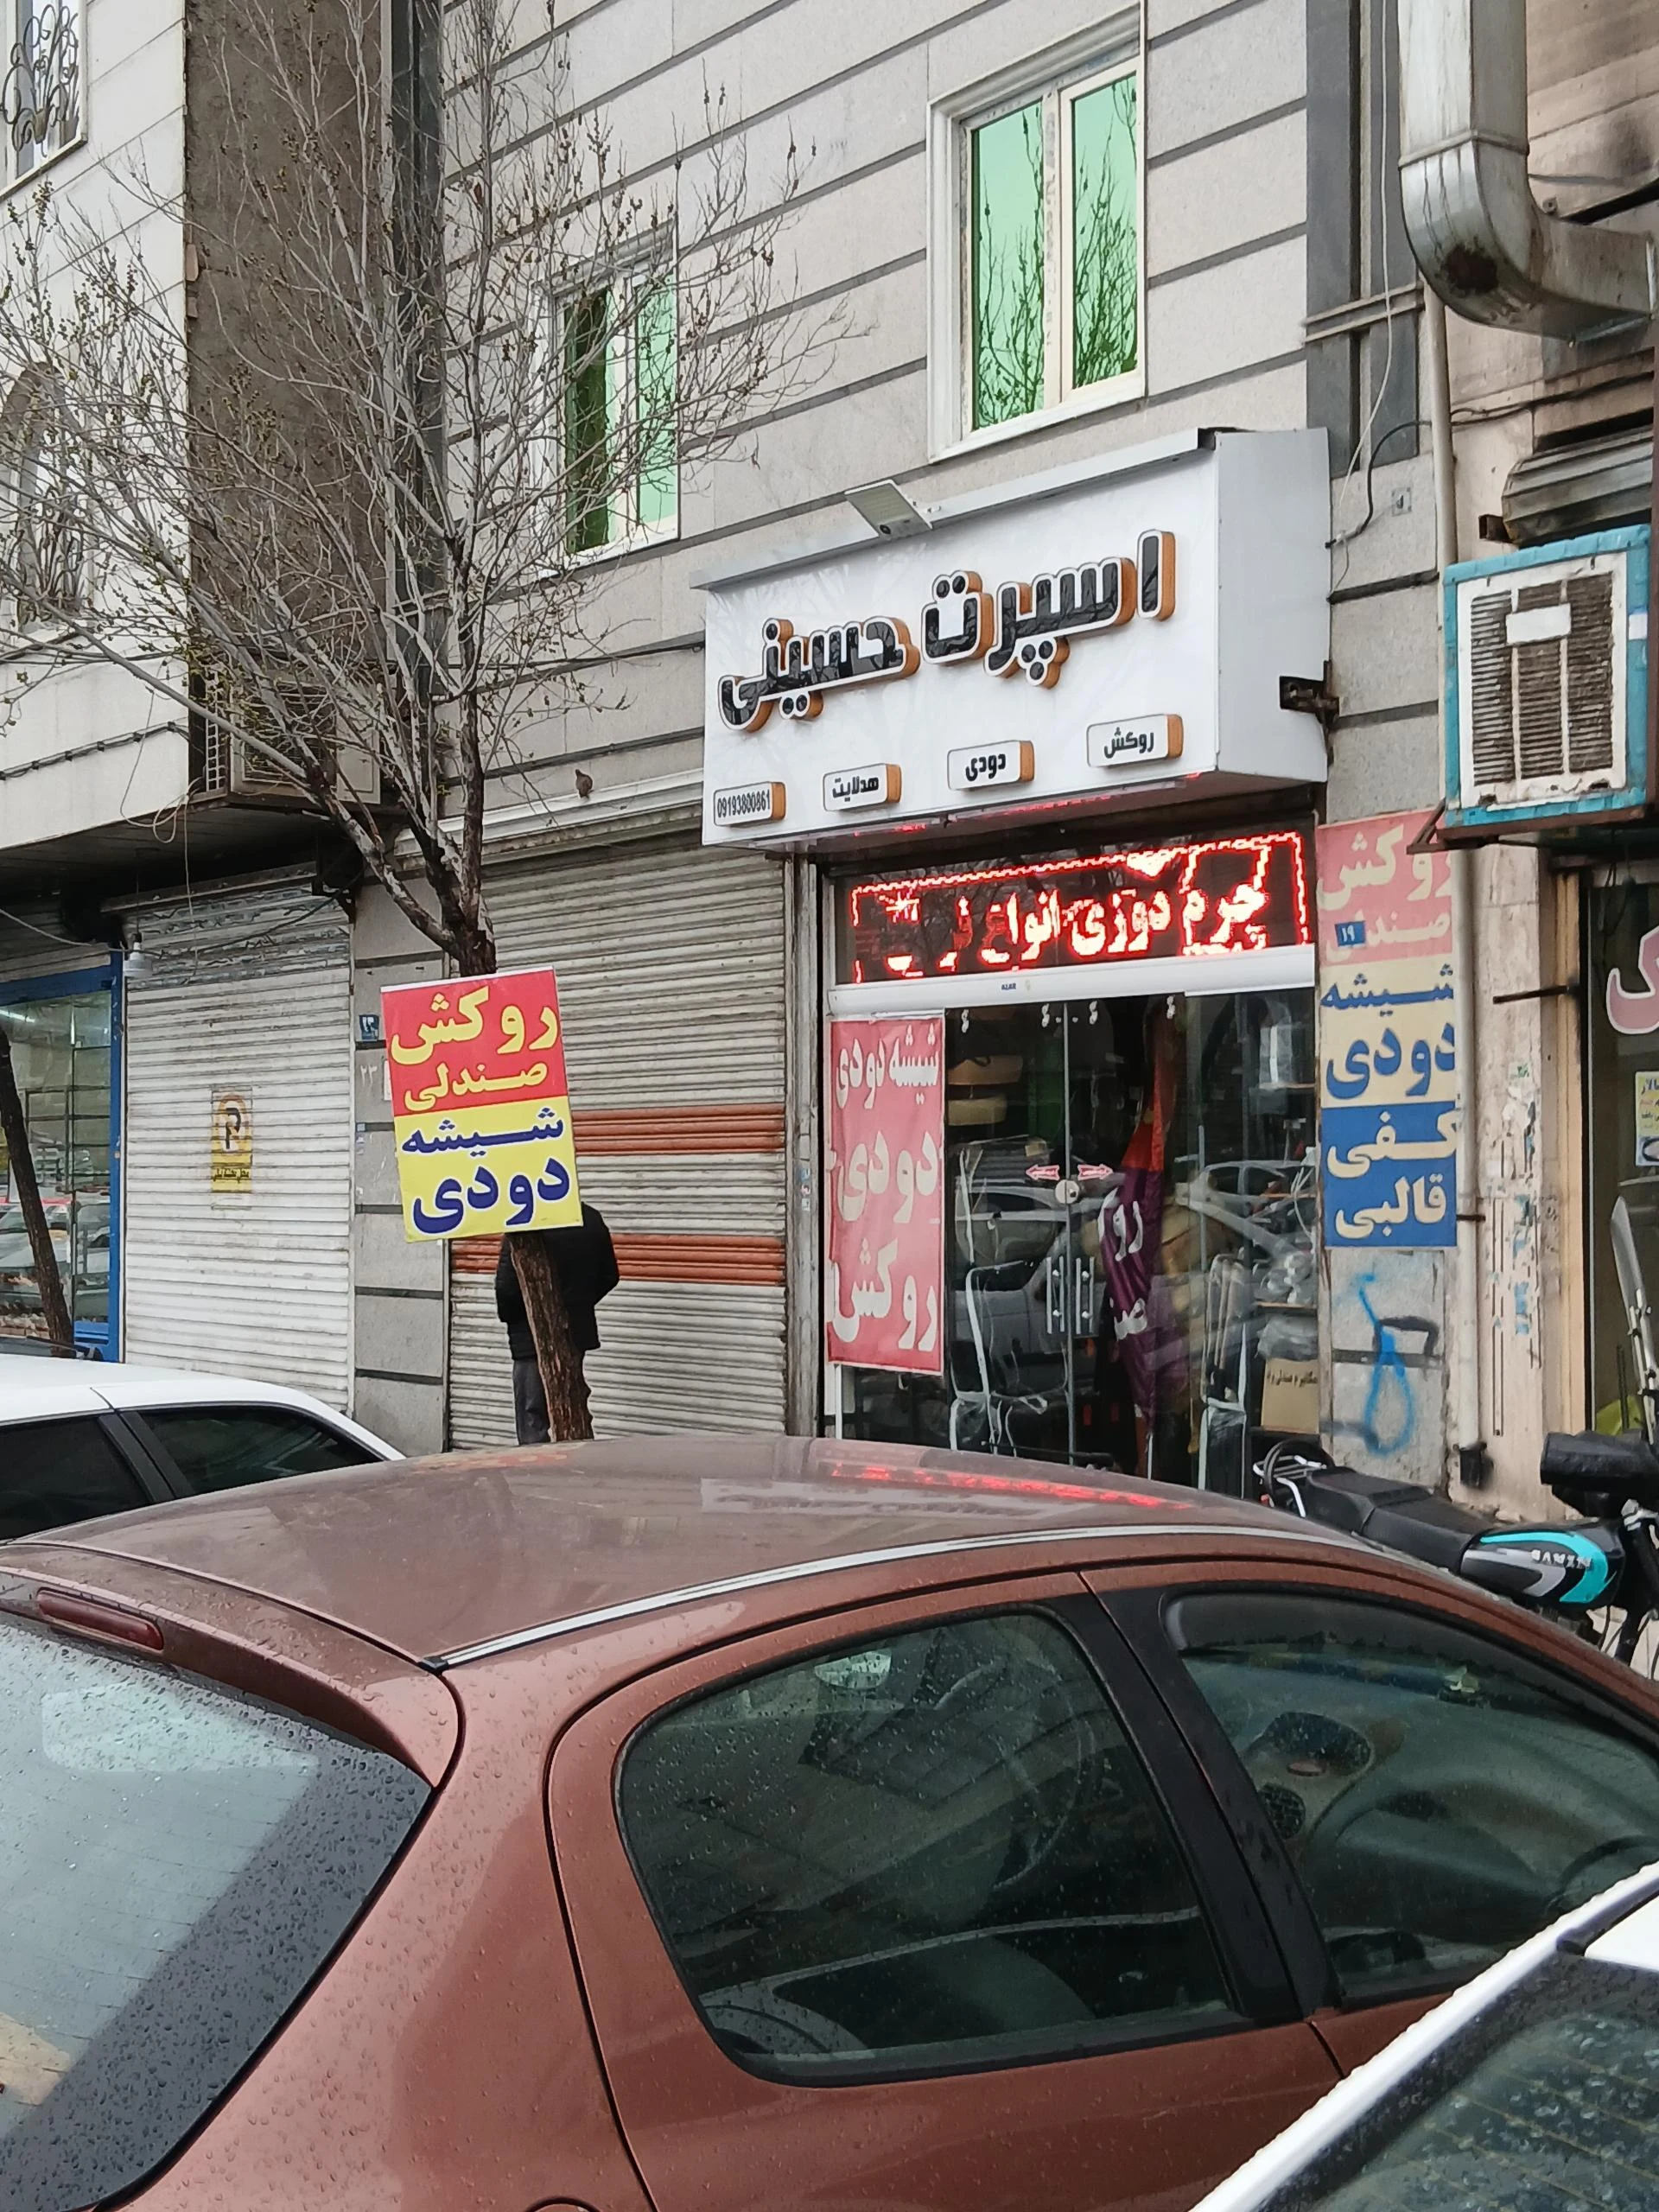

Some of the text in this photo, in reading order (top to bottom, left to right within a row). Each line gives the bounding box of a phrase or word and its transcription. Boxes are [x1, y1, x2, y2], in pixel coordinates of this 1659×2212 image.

[718, 530, 1175, 732] اسپرت حسینی
[964, 750, 1007, 781] دودی
[1103, 726, 1155, 760] روکش
[831, 775, 880, 803] هدلایت
[1320, 963, 1453, 1016] شیشه
[404, 1062, 549, 1111] صندلی
[1326, 1022, 1455, 1100] دودی
[402, 1108, 564, 1157] شیشه
[1327, 1109, 1458, 1179] کفی
[413, 1158, 570, 1233] دودی
[836, 1130, 938, 1223] دودی
[1336, 1174, 1446, 1240] قالبی
